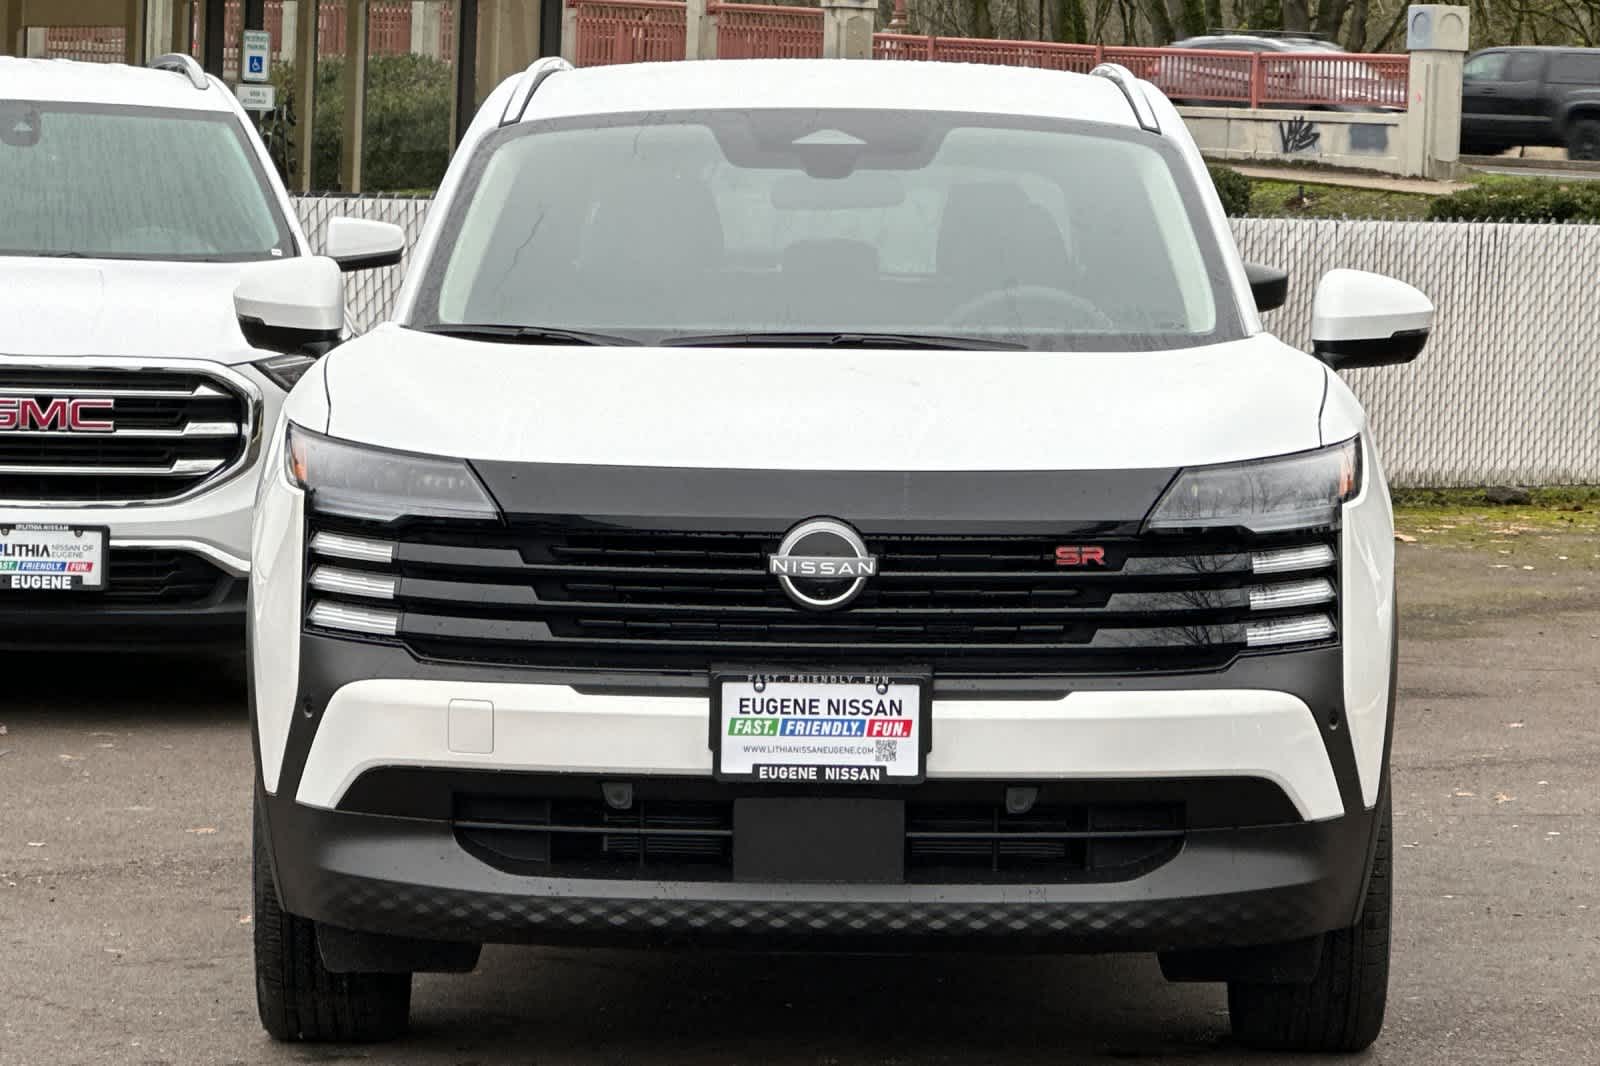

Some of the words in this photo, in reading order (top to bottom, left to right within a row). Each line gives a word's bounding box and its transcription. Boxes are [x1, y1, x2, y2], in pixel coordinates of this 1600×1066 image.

[4, 543, 51, 557] LITHIA
[82, 544, 94, 552] OF
[1055, 545, 1106, 566] SR
[772, 558, 874, 576] NISSAN
[11, 575, 72, 590] EUGENE
[738, 697, 820, 716] EUGENE
[827, 698, 903, 717] NISSAN
[734, 719, 774, 735] FAST.
[785, 720, 862, 736] FRIENDLY.
[872, 721, 908, 737] FUN.
[743, 744, 874, 755] WWW.LITHIANISSANEUGENE.COM
[759, 766, 817, 780] EUGENE
[825, 767, 880, 781] NISSAN
